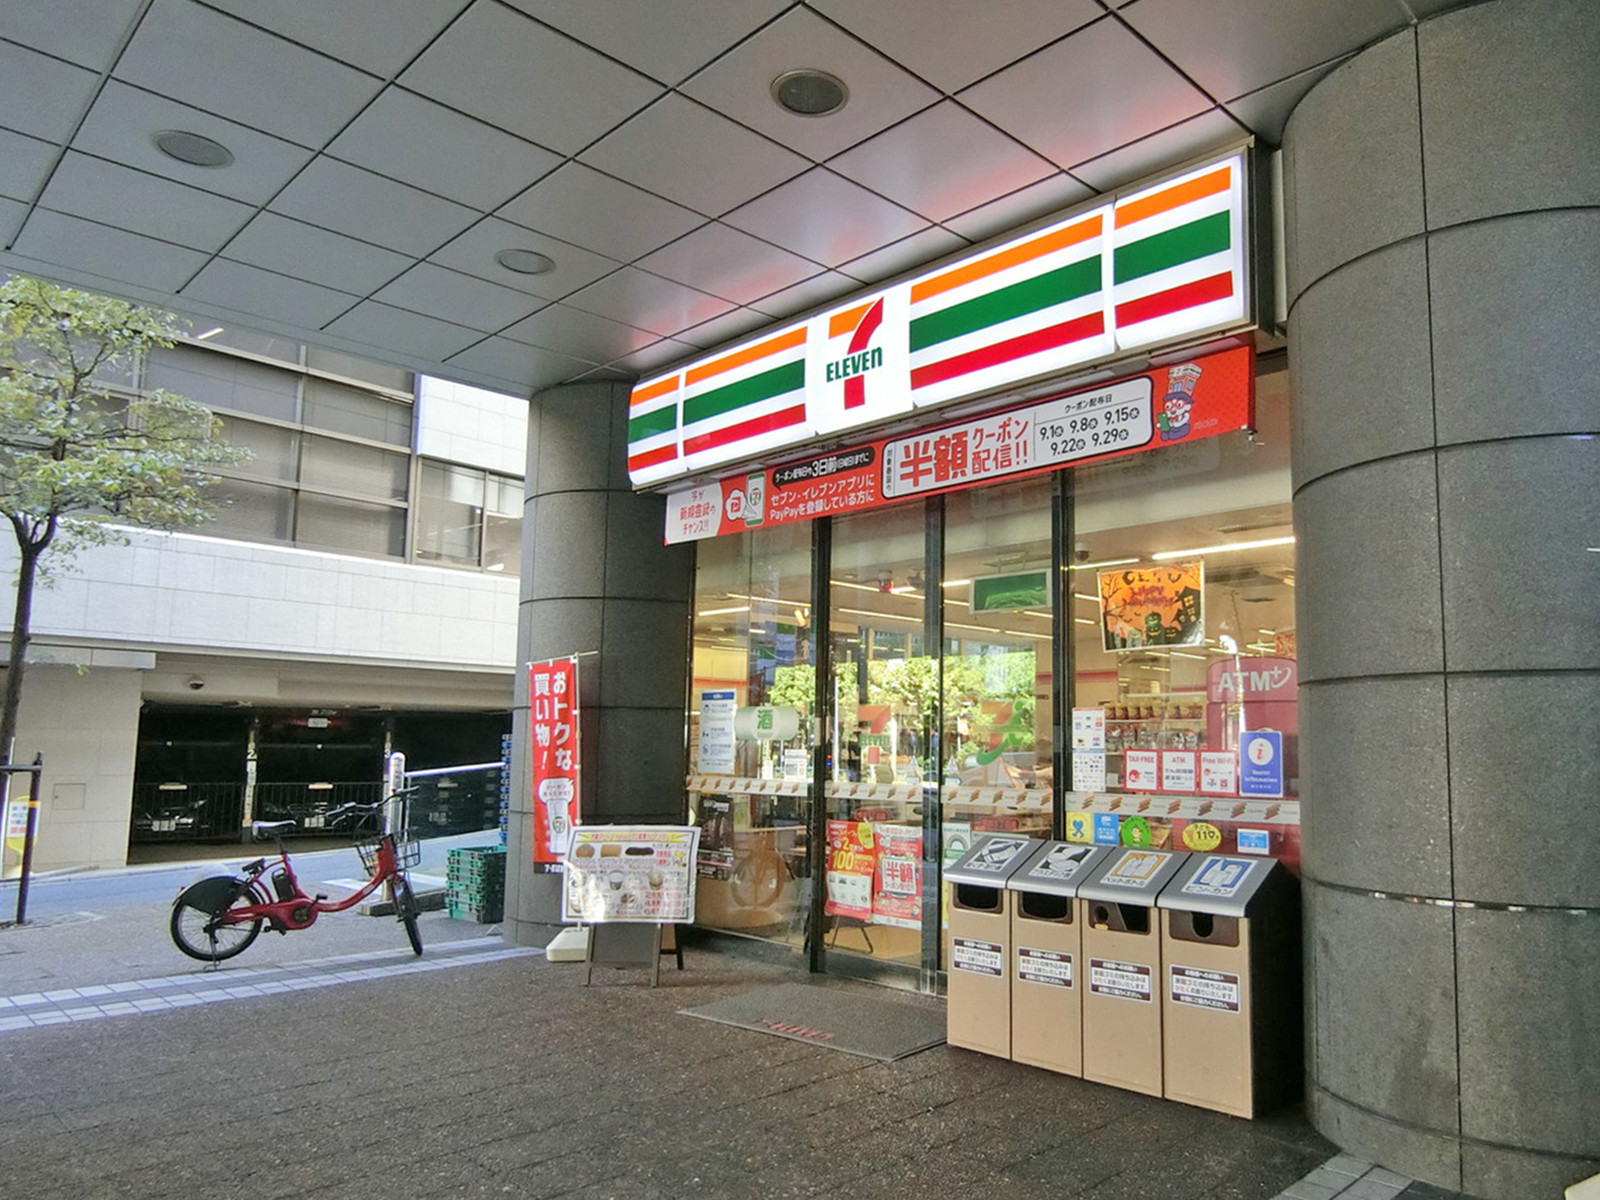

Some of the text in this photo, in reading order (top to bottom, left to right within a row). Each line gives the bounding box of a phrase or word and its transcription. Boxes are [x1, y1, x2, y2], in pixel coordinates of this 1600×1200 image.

[972, 416, 1030, 449] クーポン
[900, 430, 969, 488] 半額
[552, 671, 572, 771] おトクな
[1171, 756, 1186, 764] ATM
